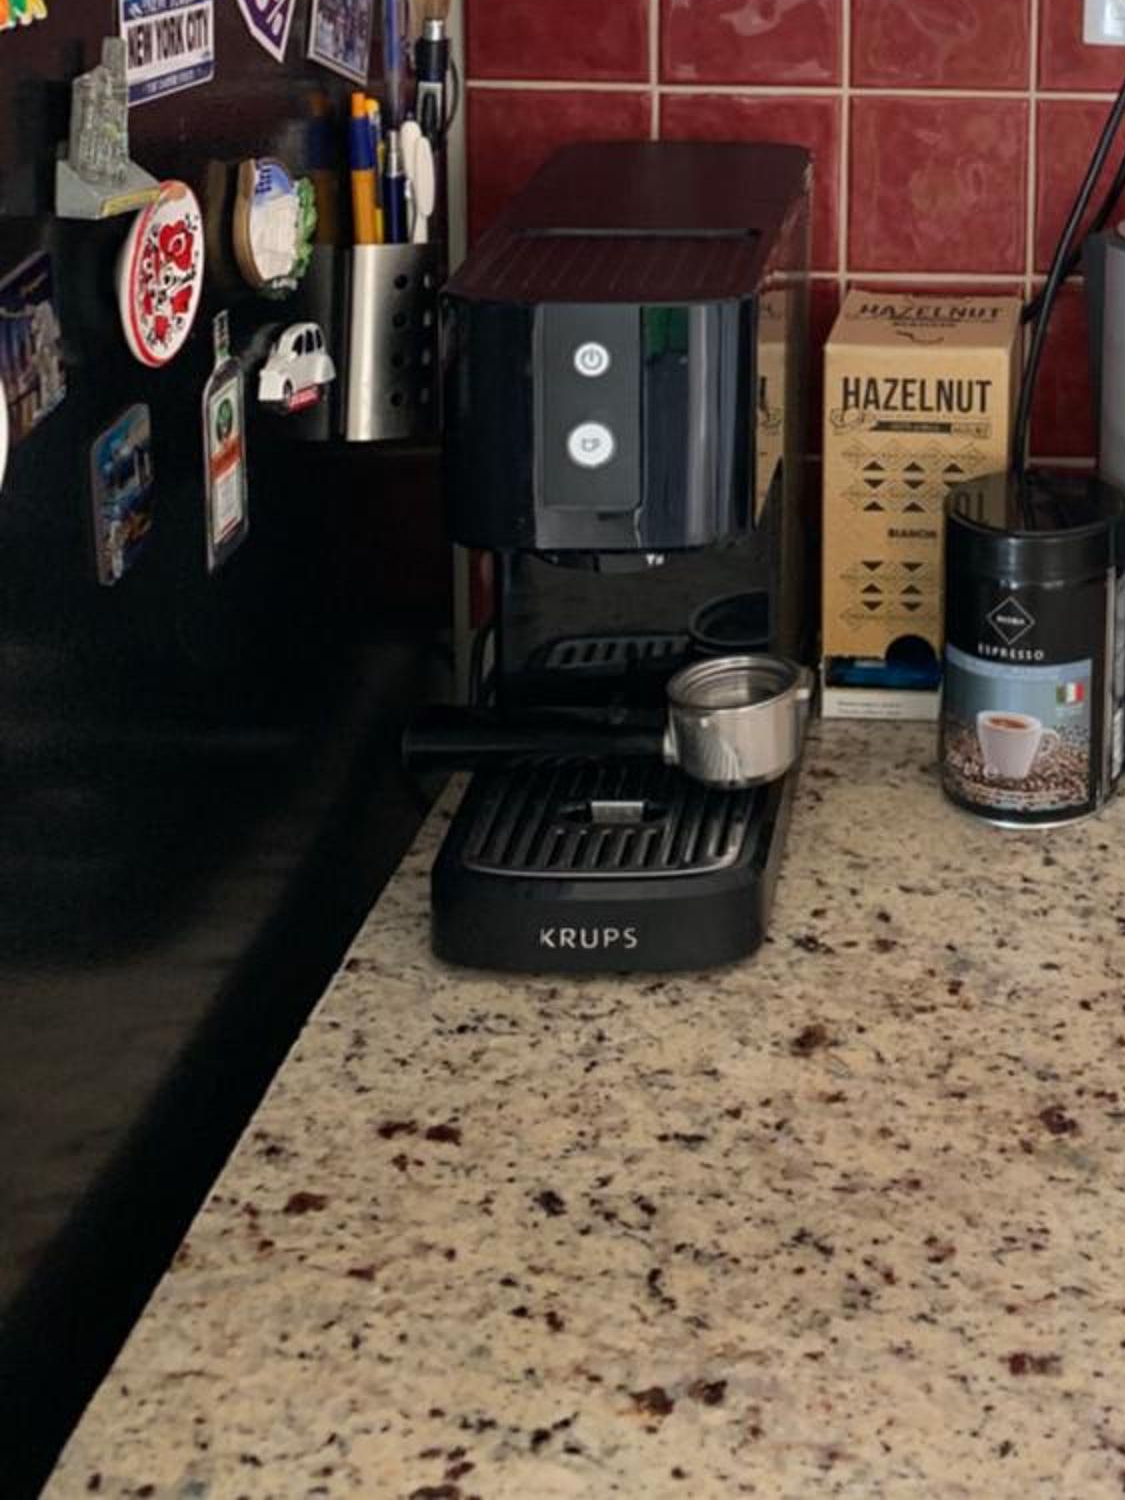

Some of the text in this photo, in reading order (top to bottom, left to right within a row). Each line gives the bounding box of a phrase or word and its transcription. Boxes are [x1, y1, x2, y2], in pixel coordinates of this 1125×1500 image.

[127, 5, 210, 70] NEW YORK CITY
[860, 303, 1003, 320] HAZELNUT
[842, 376, 992, 413] HAZELNUT
[977, 642, 1045, 661] ESPRESSO
[540, 927, 638, 949] KRUPS
